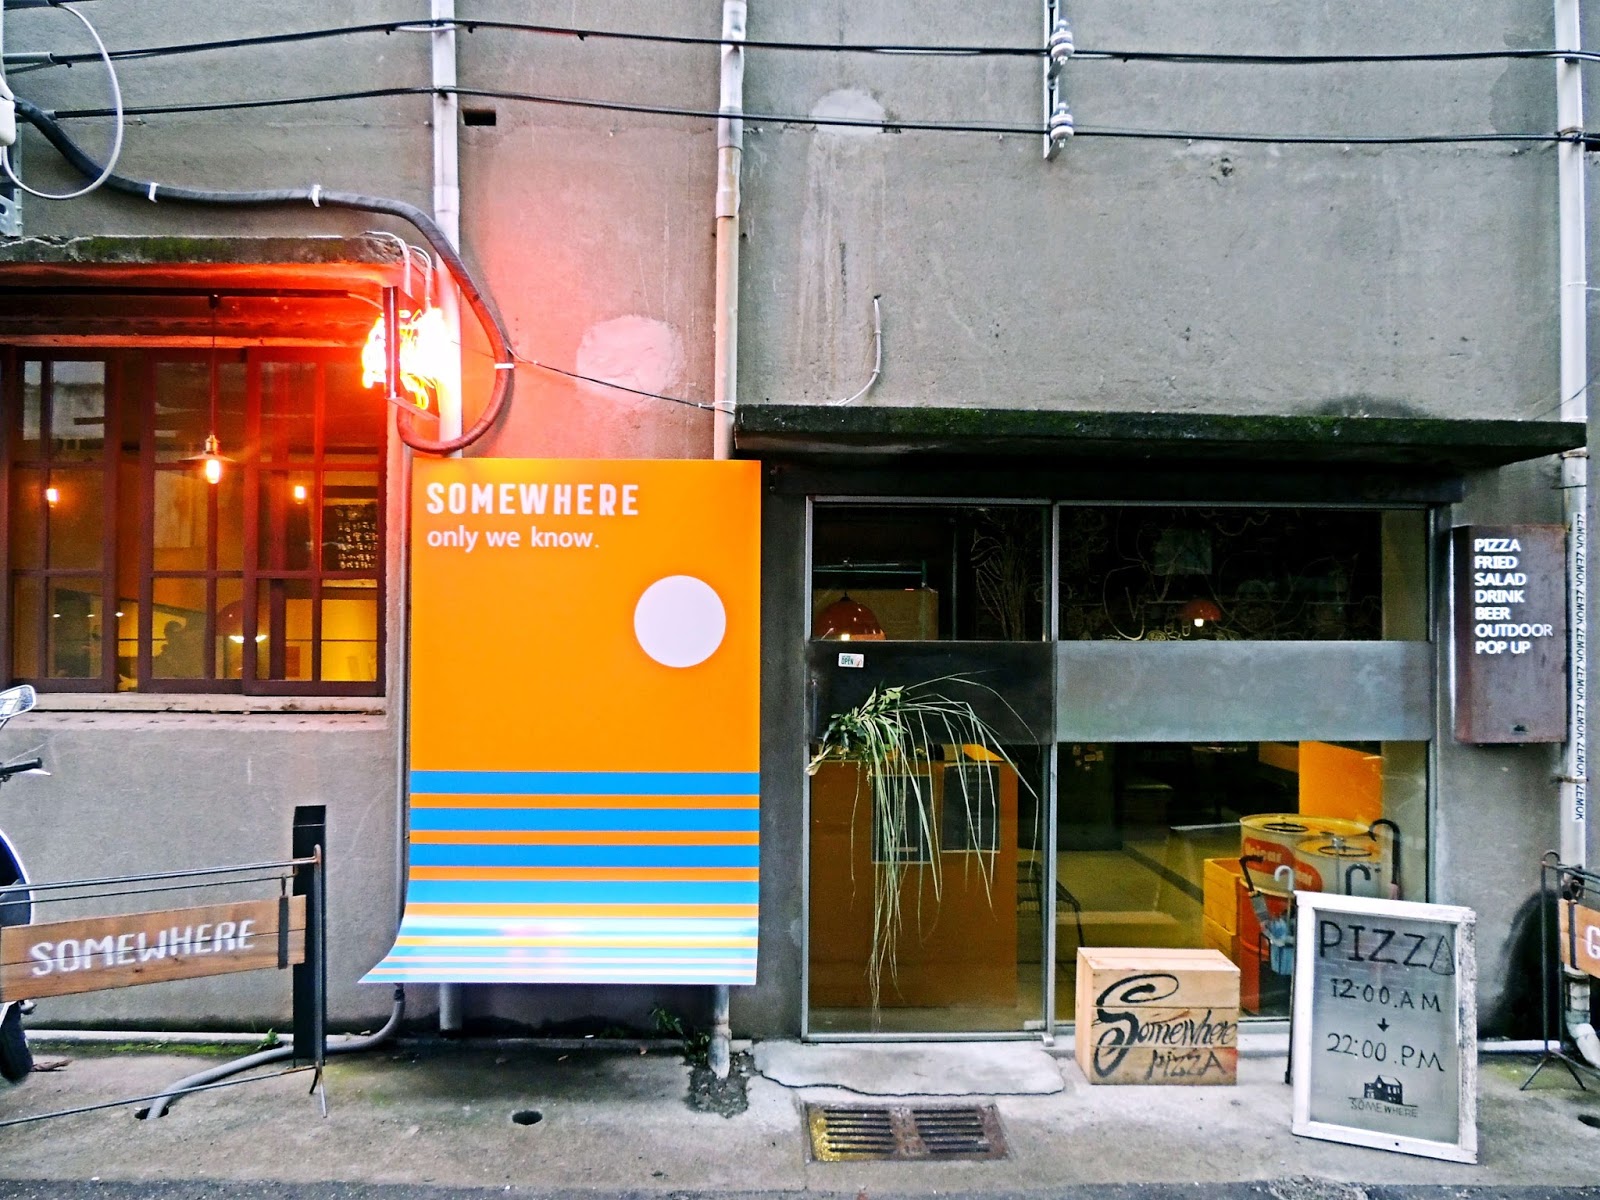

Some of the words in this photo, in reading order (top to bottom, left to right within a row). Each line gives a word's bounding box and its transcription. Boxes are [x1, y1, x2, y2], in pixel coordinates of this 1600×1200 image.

[426, 482, 639, 516] SOMEWHERE
[427, 525, 479, 553] only
[485, 530, 520, 547] we
[531, 526, 600, 548] know.
[1474, 538, 1521, 552] PIZZA
[1474, 555, 1518, 570] FRIED
[1474, 572, 1527, 587] SALAD
[1474, 589, 1526, 604] DRINK
[1475, 606, 1512, 621] BEER
[1474, 623, 1554, 638] OUTDOOR
[1475, 640, 1508, 655] POP
[1511, 640, 1532, 655] UP
[29, 919, 256, 977] SOMEWHERE
